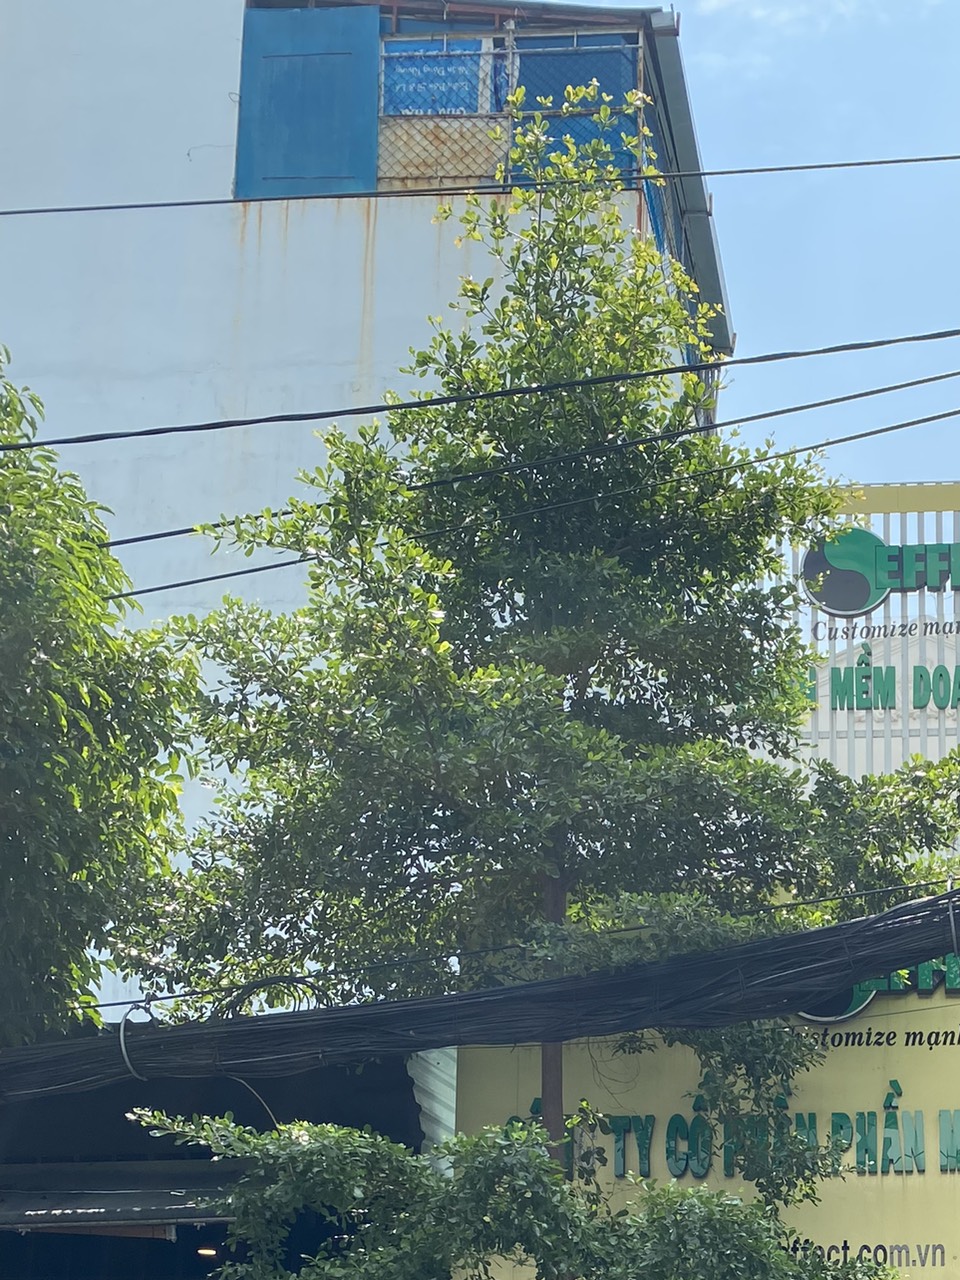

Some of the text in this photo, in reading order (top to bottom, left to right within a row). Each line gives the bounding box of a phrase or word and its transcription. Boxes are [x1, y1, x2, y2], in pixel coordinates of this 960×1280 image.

[812, 617, 918, 642] Customize
[831, 643, 896, 711] MỀM
[609, 1114, 656, 1179] TY
[831, 1079, 926, 1176] PHẦN
